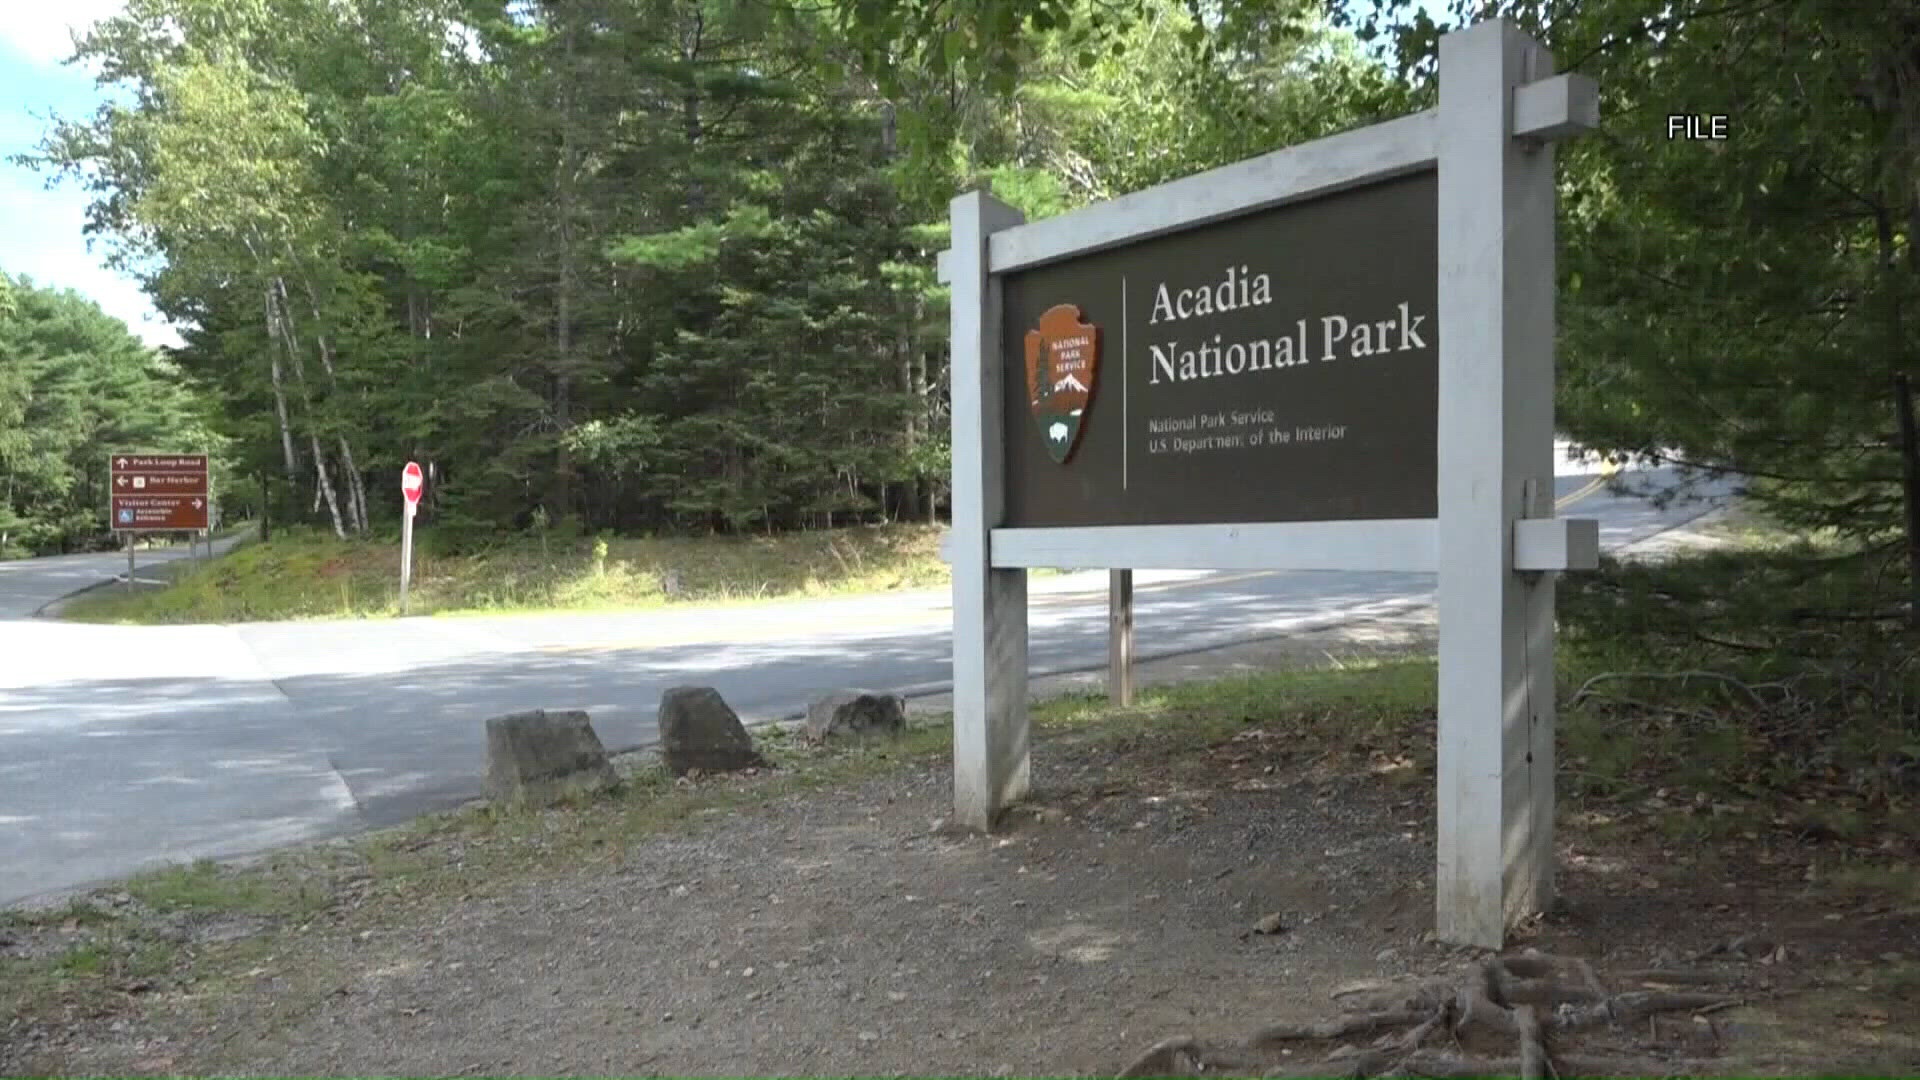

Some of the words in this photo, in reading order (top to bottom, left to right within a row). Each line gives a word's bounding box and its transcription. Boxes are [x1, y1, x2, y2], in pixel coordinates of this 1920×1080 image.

[1149, 265, 1273, 325] Acadia
[1052, 336, 1089, 350] NATIONAL
[1149, 319, 1310, 384] National
[1320, 301, 1426, 361] Park
[1060, 350, 1081, 360] PARK
[1056, 360, 1086, 372] SERVICE
[1149, 415, 1197, 433] National
[1200, 412, 1226, 428] Park
[1230, 406, 1275, 425] Service
[1249, 429, 1264, 445] of
[1269, 427, 1291, 443] the
[1296, 424, 1347, 442] Interior
[133, 458, 153, 466] Park
[179, 458, 201, 466] Road
